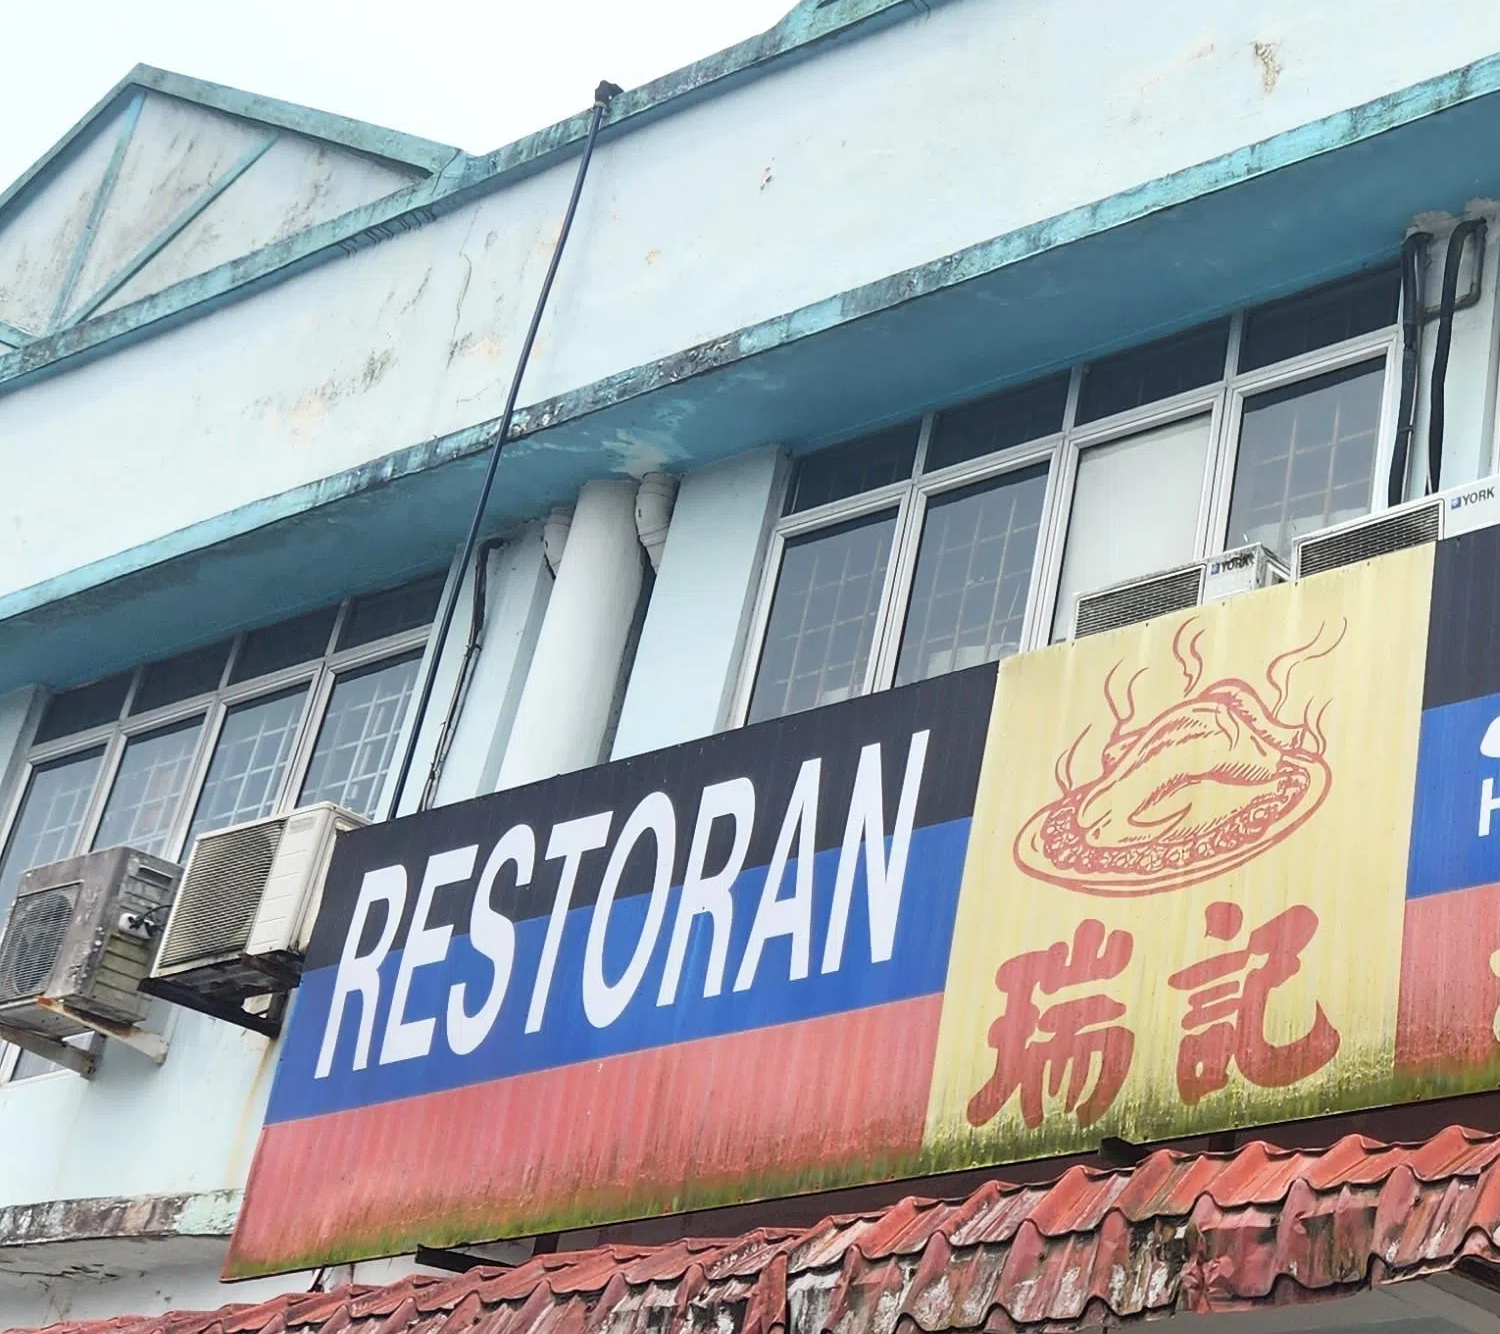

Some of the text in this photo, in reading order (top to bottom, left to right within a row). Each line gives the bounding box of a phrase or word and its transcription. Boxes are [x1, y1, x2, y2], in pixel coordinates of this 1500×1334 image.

[1462, 486, 1495, 505] YORK
[1220, 554, 1255, 573] YORK
[314, 729, 930, 1080] RESTORAN
[966, 901, 1341, 1129] 瑞記
